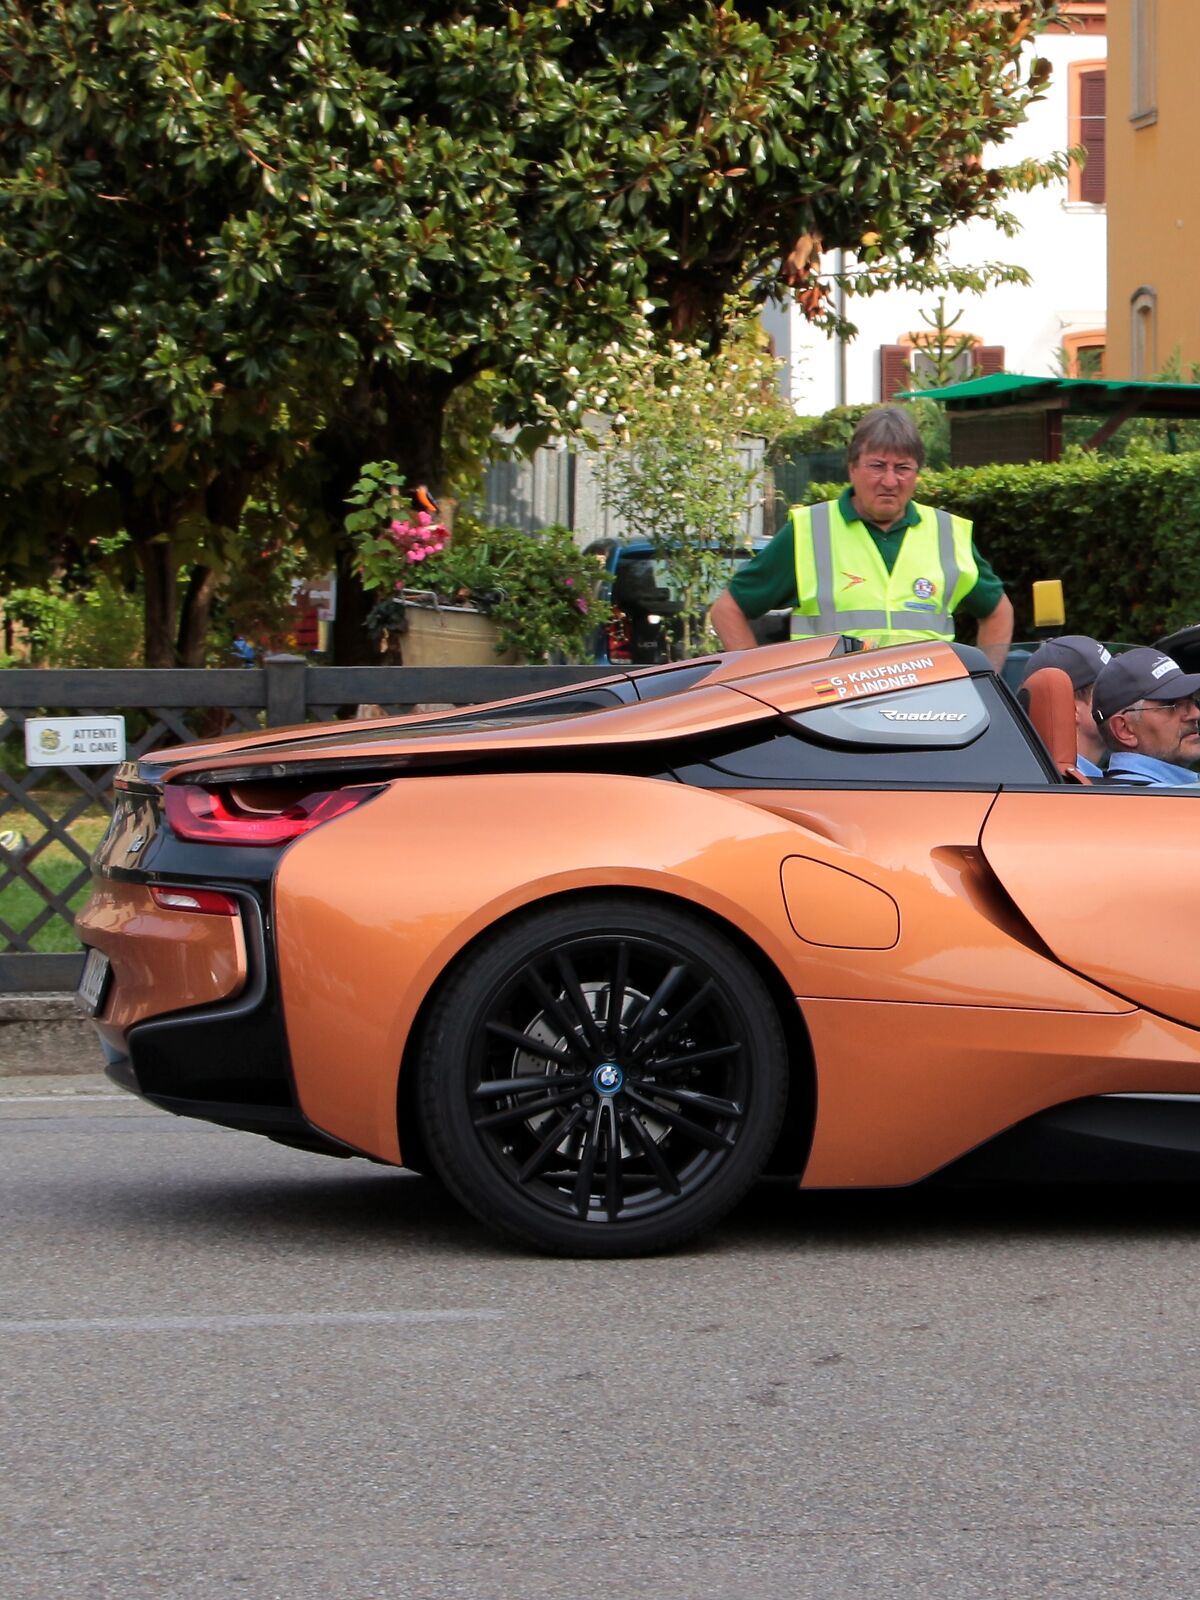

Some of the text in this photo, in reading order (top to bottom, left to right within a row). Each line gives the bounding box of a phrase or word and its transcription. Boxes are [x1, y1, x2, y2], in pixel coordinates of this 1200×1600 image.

[830, 657, 934, 687] G. KAUFMANN
[853, 673, 919, 696] LINDNER
[879, 709, 967, 722] Roadster
[73, 728, 117, 739] ATTENTI
[73, 743, 87, 753] AL
[90, 742, 118, 752] CANE
